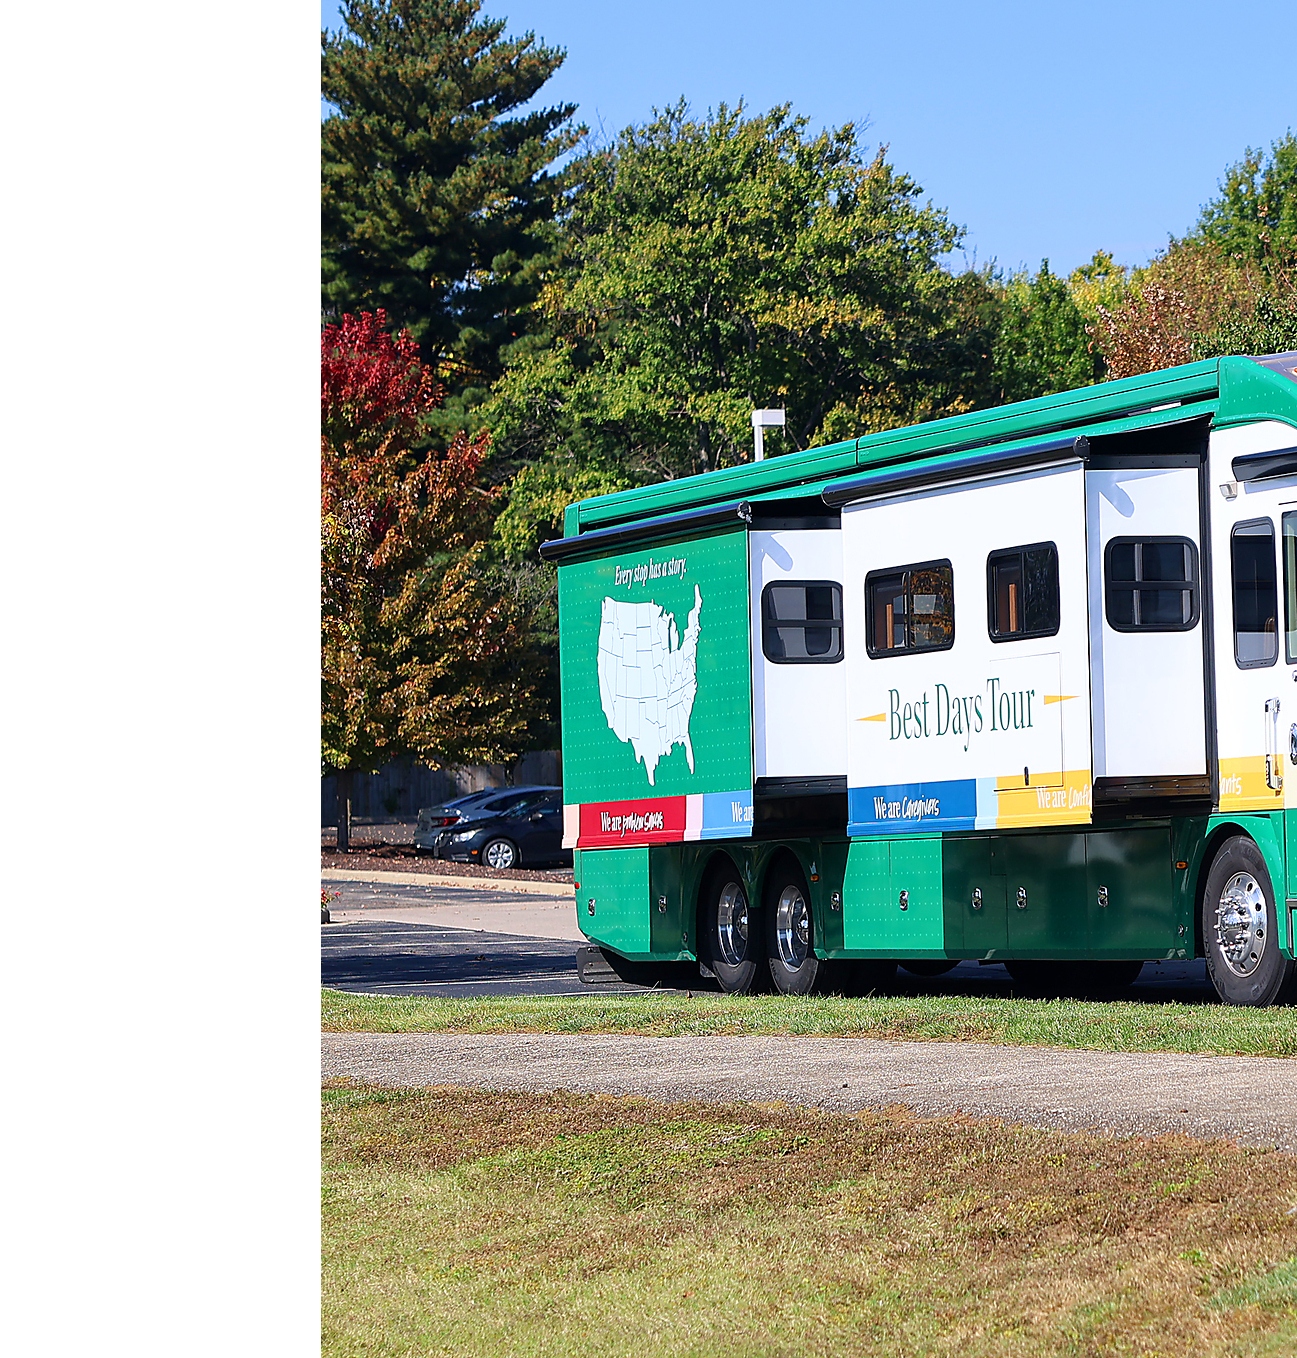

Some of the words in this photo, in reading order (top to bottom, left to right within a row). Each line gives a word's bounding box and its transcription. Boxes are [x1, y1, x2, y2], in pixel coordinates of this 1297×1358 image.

[614, 565, 634, 589] Every
[633, 563, 648, 587] stop
[648, 557, 662, 580] has
[662, 561, 668, 577] a
[667, 557, 687, 580] story.
[888, 688, 931, 741] Best
[935, 683, 983, 752] Days
[986, 677, 1035, 732] Tour
[874, 796, 887, 820] We
[887, 801, 901, 819] are
[901, 794, 940, 822] Caregivers
[1036, 787, 1051, 809] We
[1052, 790, 1067, 808] are
[600, 811, 612, 832] We
[611, 815, 622, 832] are
[731, 801, 743, 823] We
